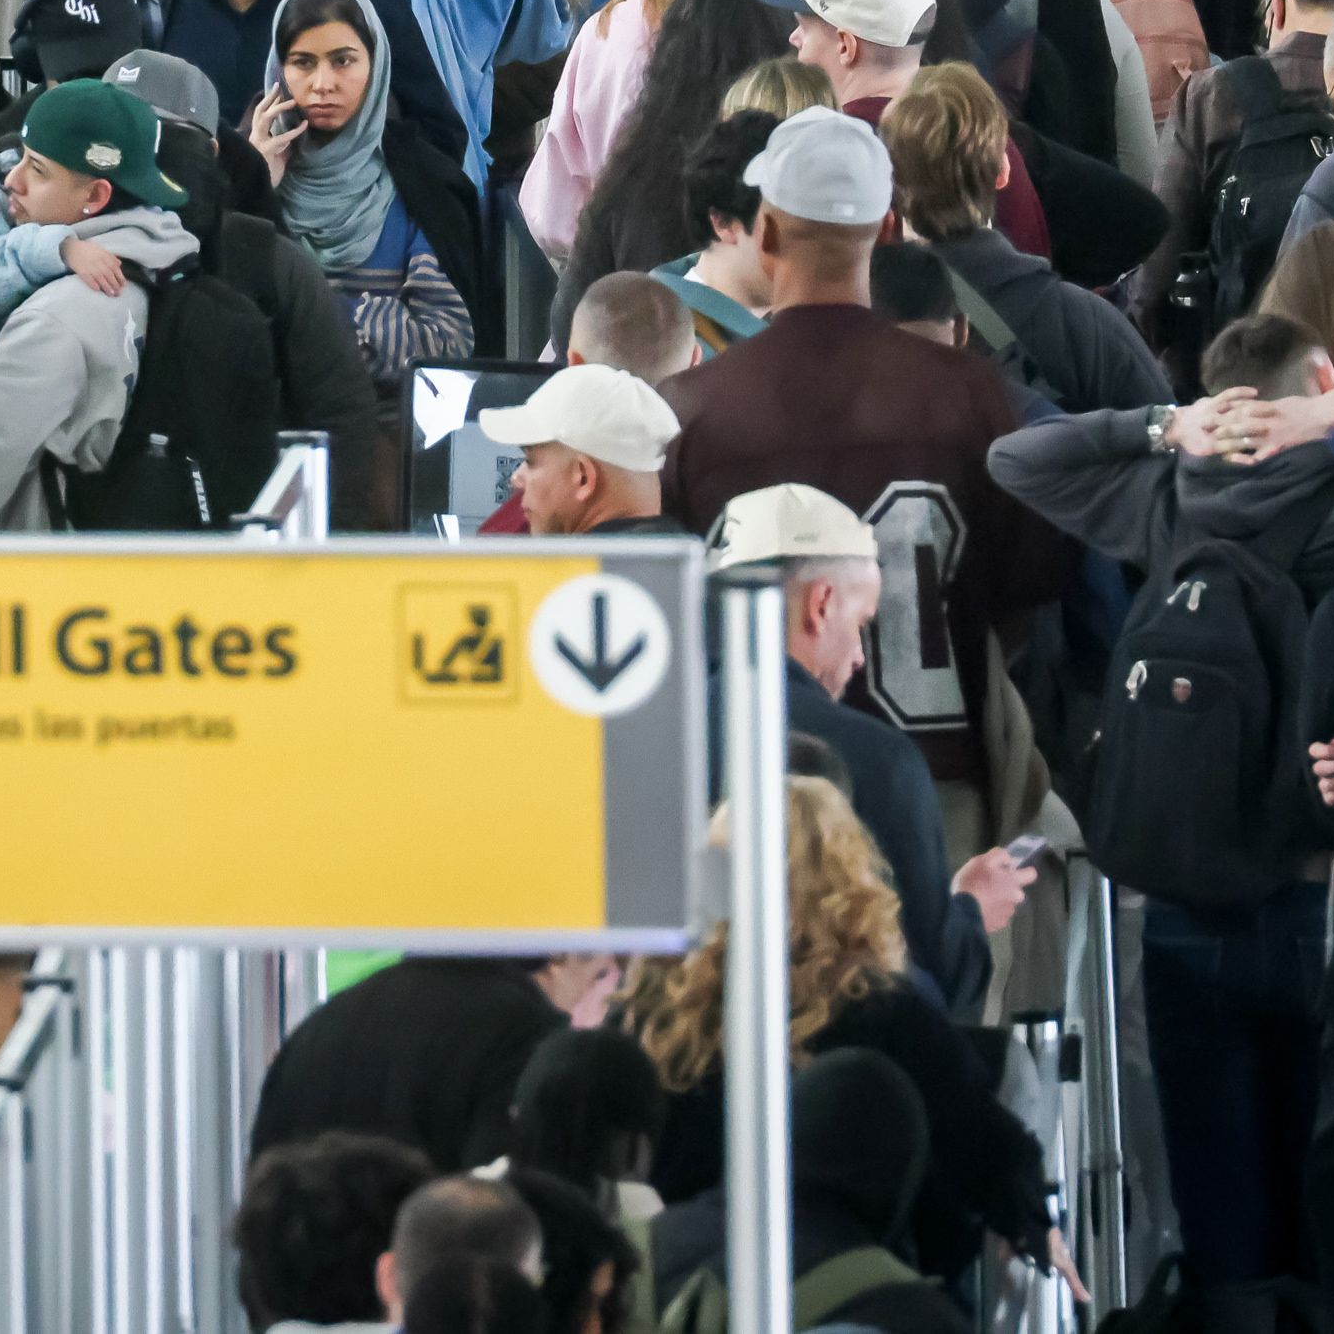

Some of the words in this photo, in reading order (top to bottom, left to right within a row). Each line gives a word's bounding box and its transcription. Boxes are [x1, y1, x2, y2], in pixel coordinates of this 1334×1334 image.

[55, 606, 297, 678] Gates
[37, 712, 82, 739] las
[97, 714, 235, 747] puertas
